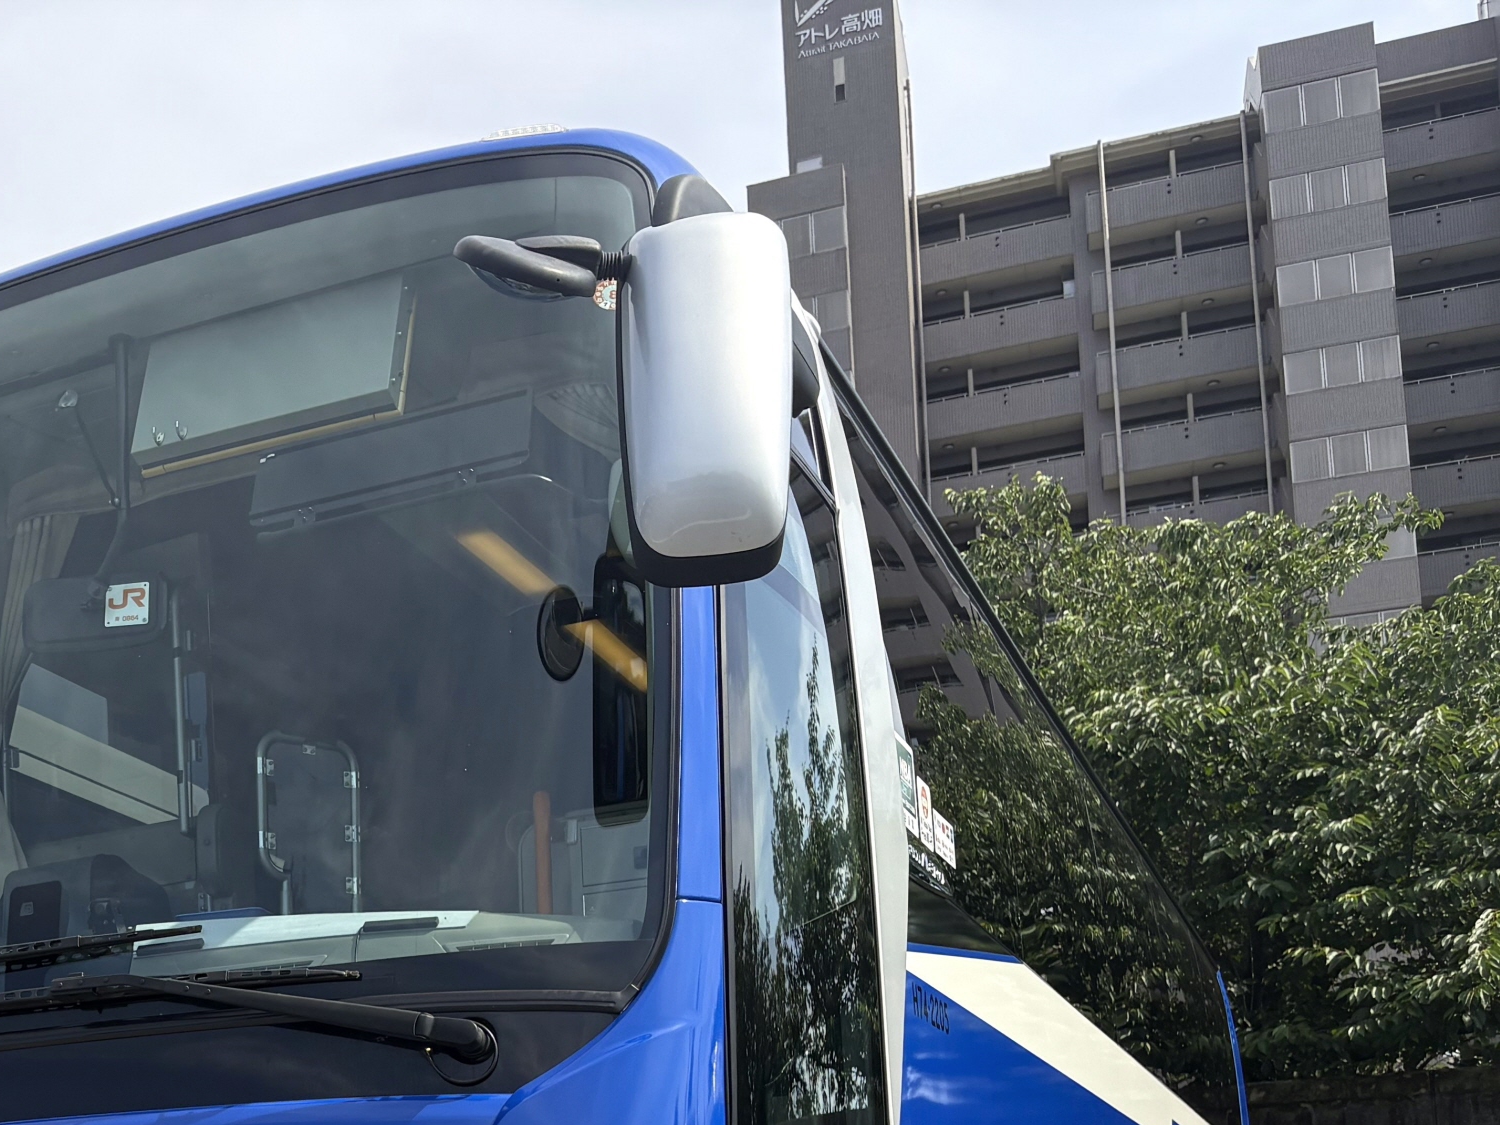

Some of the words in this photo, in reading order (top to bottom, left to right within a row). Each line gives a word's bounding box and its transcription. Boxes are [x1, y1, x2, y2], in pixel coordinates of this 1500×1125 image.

[795, 7, 883, 47] アトレ高畑
[829, 32, 880, 52] TAKABATA
[108, 588, 146, 610] JR
[912, 982, 949, 1034] H74-2205
